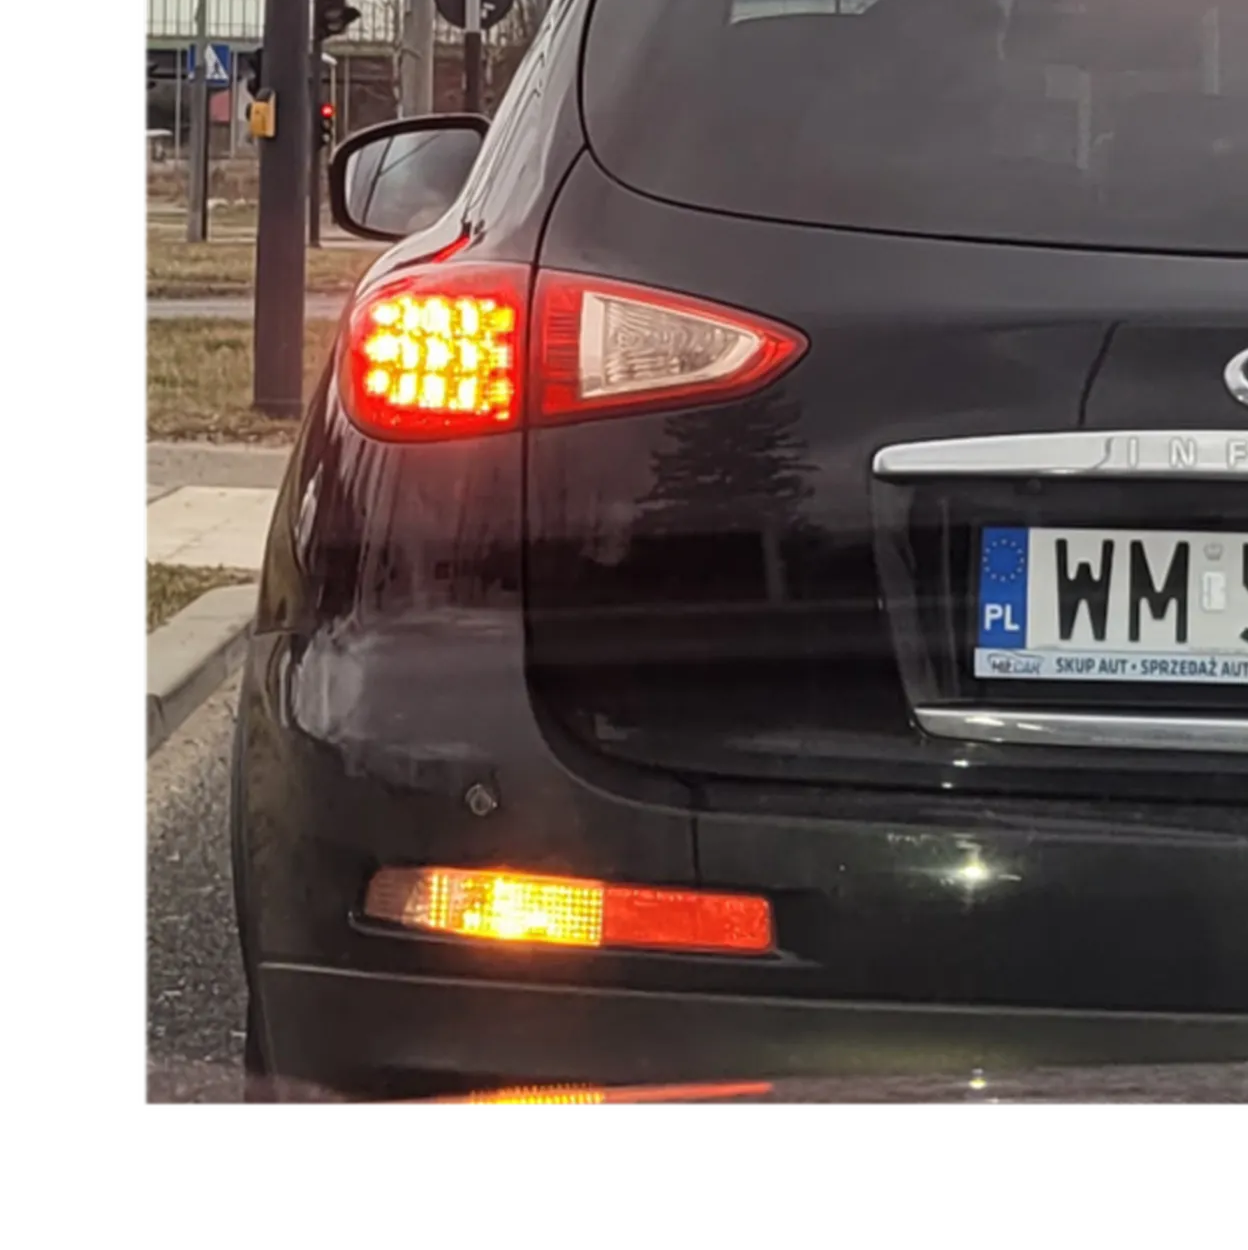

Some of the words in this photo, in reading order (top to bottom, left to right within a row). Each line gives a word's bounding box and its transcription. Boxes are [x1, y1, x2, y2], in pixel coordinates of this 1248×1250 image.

[1055, 538, 1190, 644] WM
[984, 603, 1021, 631] PL
[1056, 657, 1095, 673] SKUP
[1099, 658, 1128, 675] AUT
[1140, 657, 1218, 677] SPRZEDAŻ
